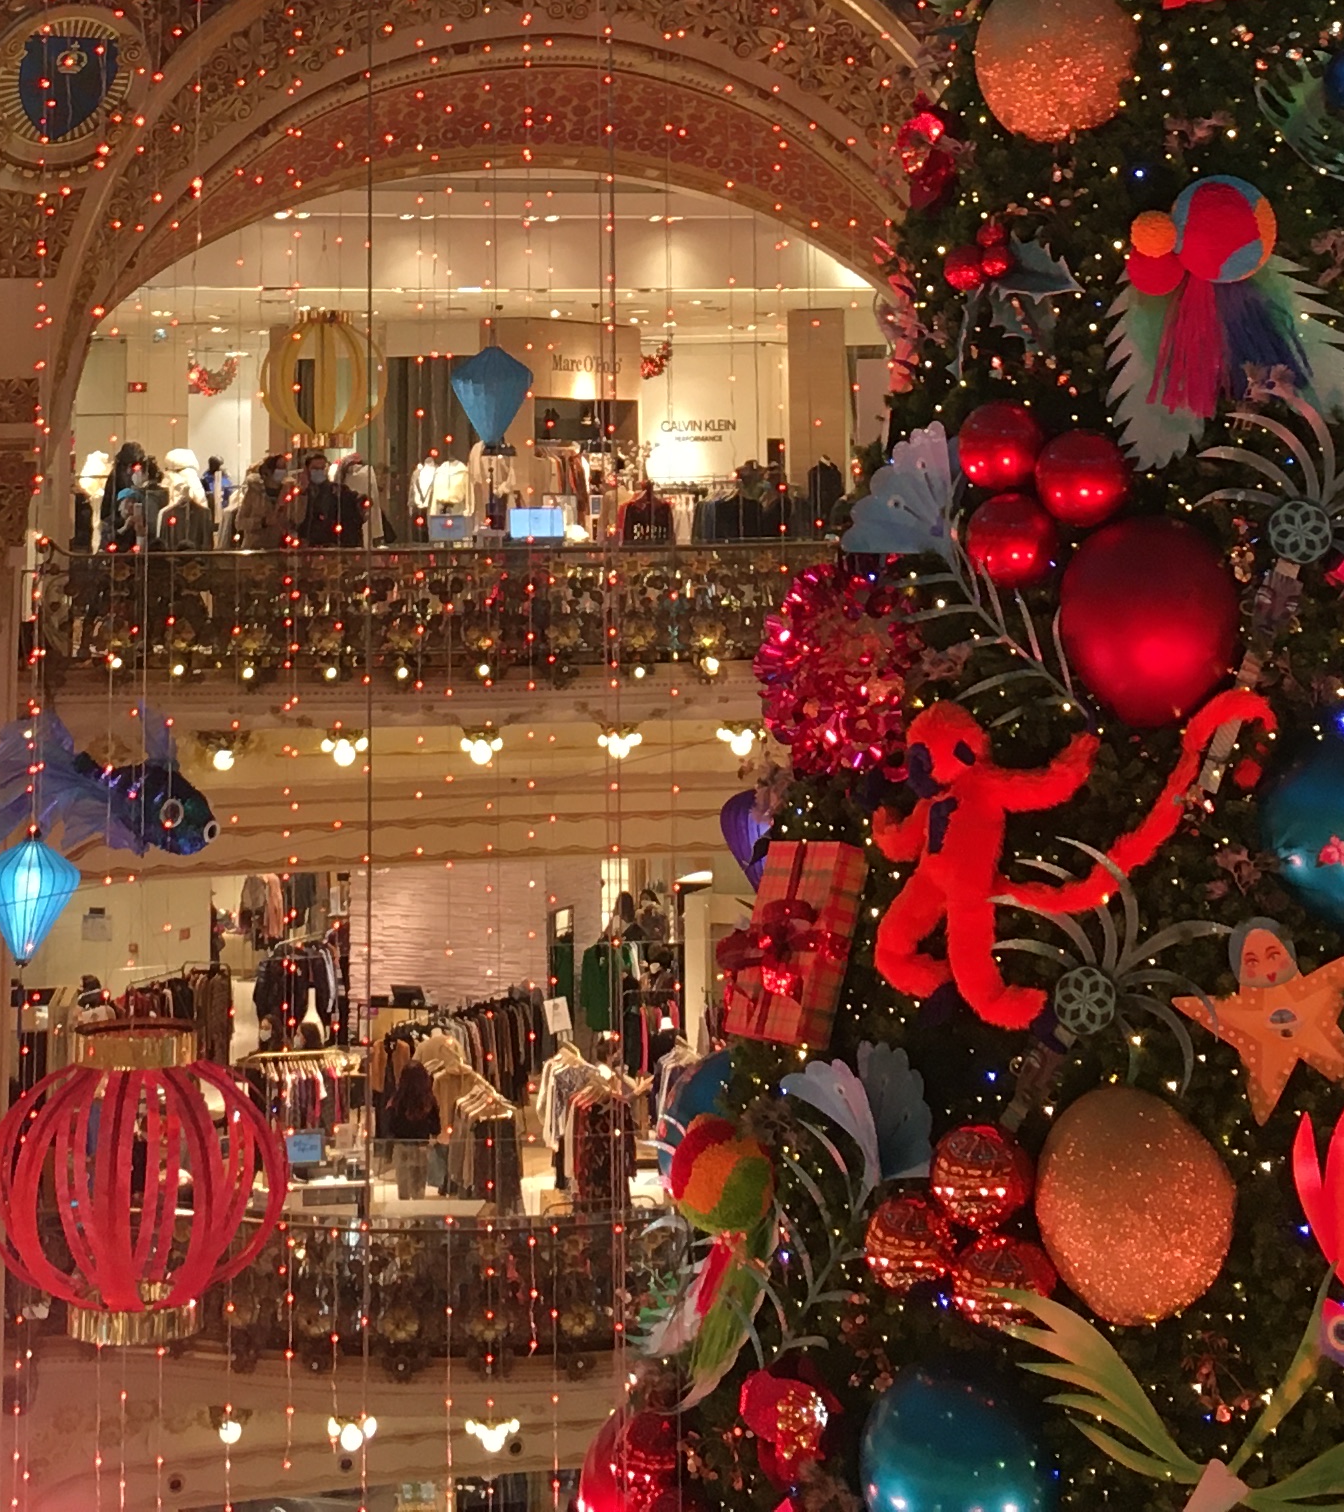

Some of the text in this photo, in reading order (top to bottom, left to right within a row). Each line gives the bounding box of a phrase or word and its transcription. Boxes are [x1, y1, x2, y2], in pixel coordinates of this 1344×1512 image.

[552, 354, 582, 372] Marc
[660, 419, 736, 433] CALVIN KLEIN
